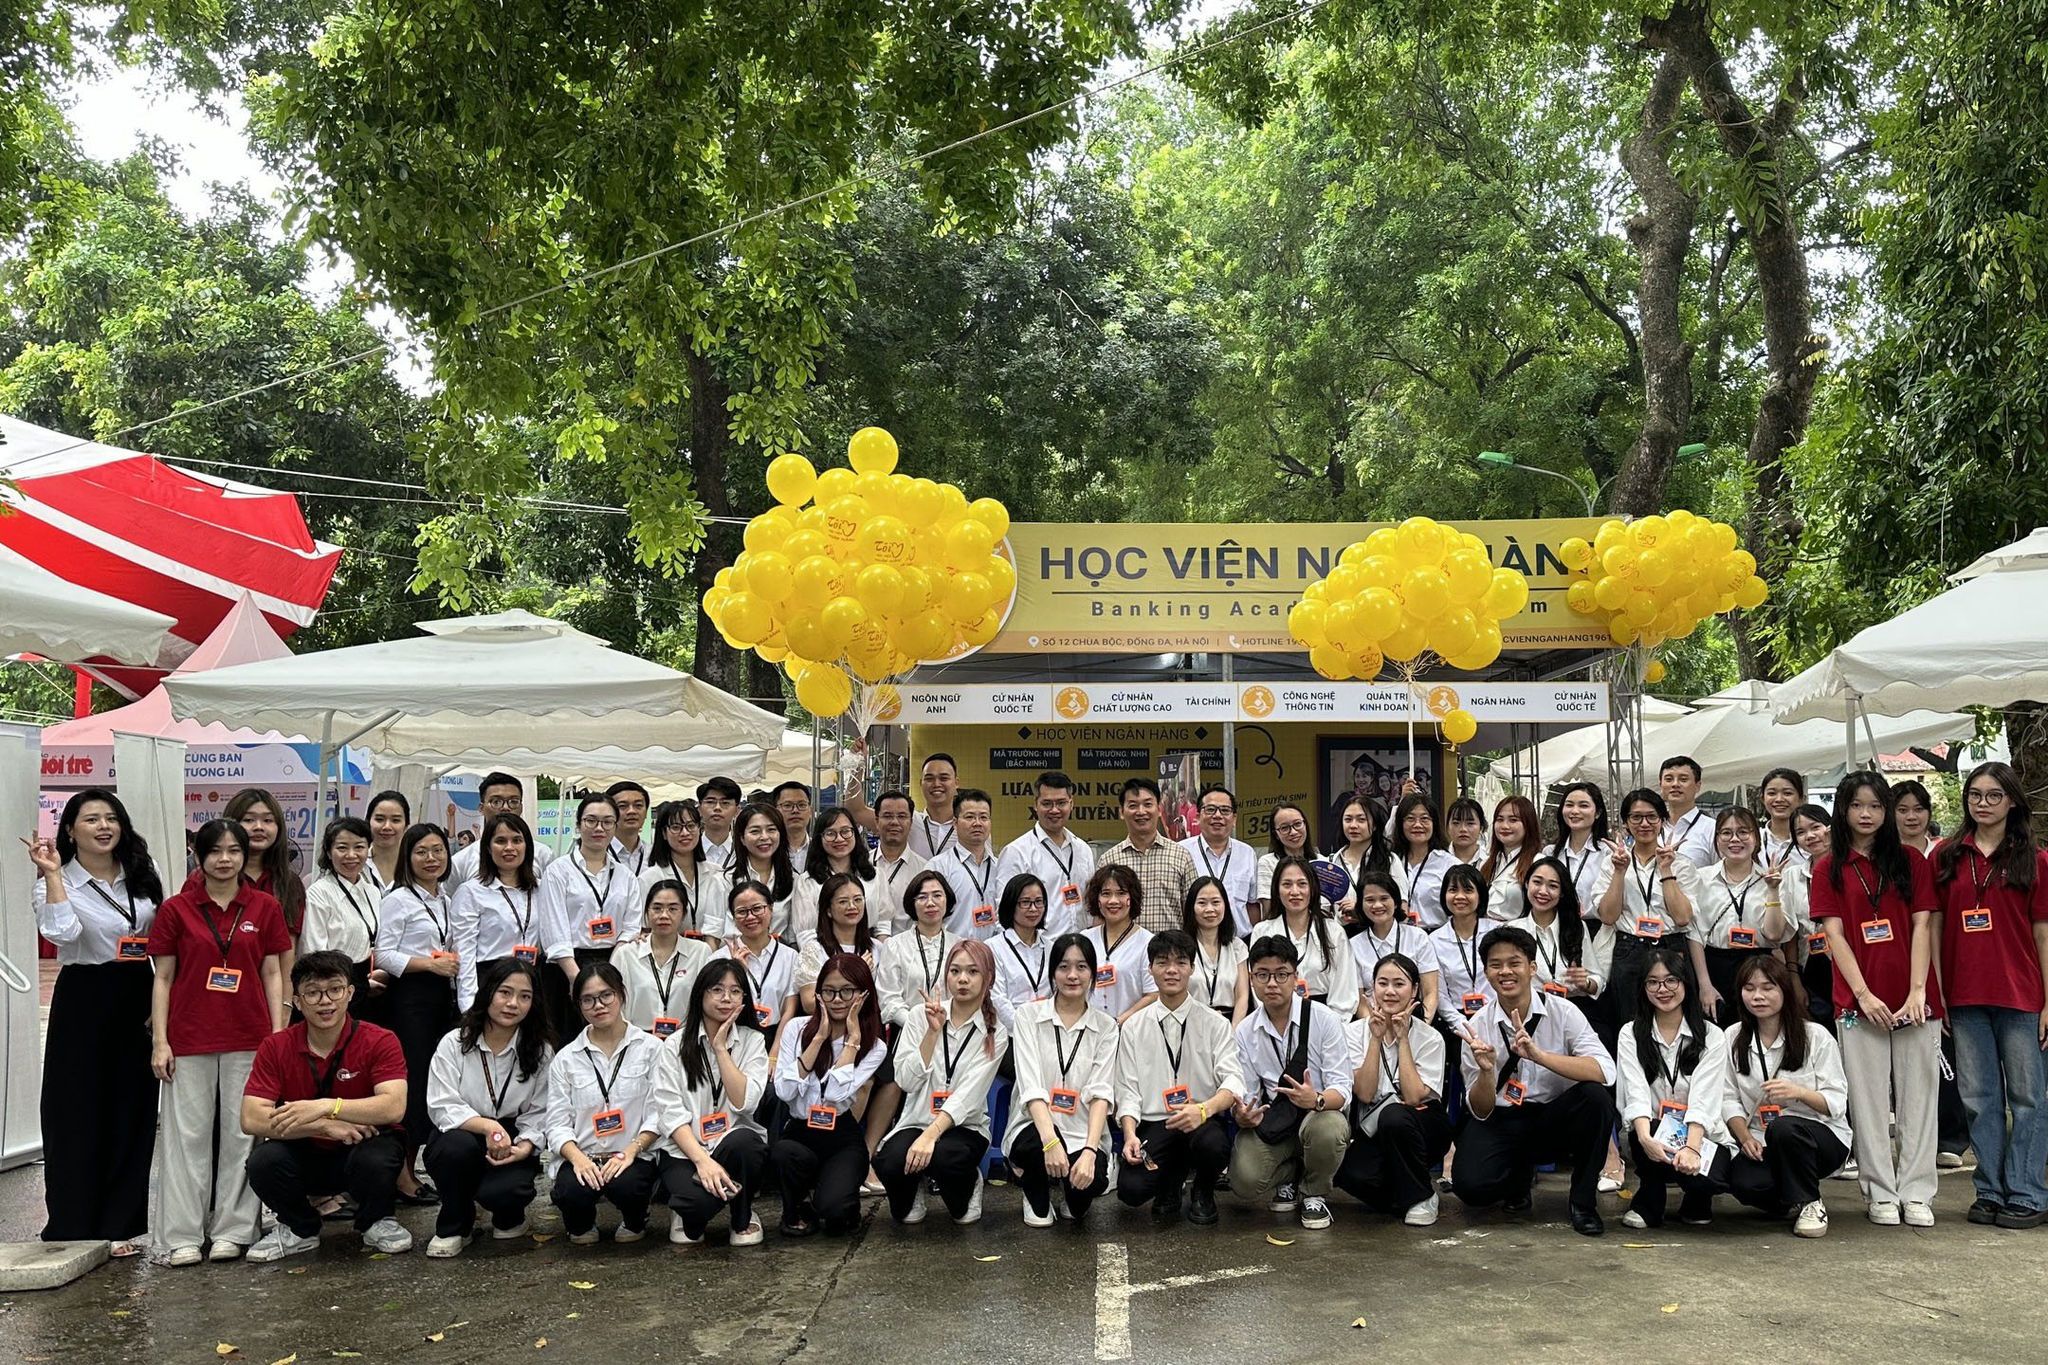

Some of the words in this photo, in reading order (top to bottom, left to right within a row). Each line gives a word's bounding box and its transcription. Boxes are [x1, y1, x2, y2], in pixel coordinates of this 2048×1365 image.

[1041, 547, 1147, 587] HỌC
[1163, 539, 1279, 587] VIỆN
[1091, 601, 1210, 619] Banking
[1042, 637, 1056, 646] SỐ
[1059, 638, 1070, 646] 12
[1175, 637, 1189, 646] HÀ
[1242, 638, 1283, 646] HOTLINE
[1502, 634, 1611, 643] CVIENNGANHANG1961
[911, 693, 938, 703] NGÔN
[940, 693, 961, 703] NGỮ
[992, 692, 1006, 702] CỬ
[1007, 692, 1034, 702] NHÂN
[1111, 692, 1126, 701] CỬ
[1127, 692, 1153, 701] NHÂN
[1283, 691, 1308, 700] CÔNG
[1310, 691, 1336, 701] NGHỆ
[1366, 691, 1392, 701] QUẢN
[1470, 695, 1497, 705] NGÂN
[1499, 695, 1526, 706] HÀNG
[1554, 691, 1568, 700] CỬ
[1570, 691, 1597, 700] NHÂN
[1185, 696, 1200, 706] TÀI
[1201, 696, 1231, 706] CHÍNH
[994, 703, 1020, 713] QUỐC
[1021, 703, 1033, 713] TẾ
[1092, 703, 1117, 712] CHẤT
[1119, 703, 1151, 713] LƯỢNG
[1153, 704, 1172, 712] CAO
[1285, 702, 1317, 711] THÔNG
[1320, 703, 1334, 711] TIN
[1359, 703, 1380, 711] KINH
[1556, 703, 1582, 711] QUỐC
[1584, 702, 1596, 711] TẾ
[1036, 728, 1066, 741] HỌC
[1070, 726, 1101, 741] VIỆN
[1105, 726, 1145, 740] NGÂN
[1149, 726, 1189, 740] HÀNG
[1025, 760, 1048, 768] NINH)
[228, 767, 244, 776] LAI
[1001, 782, 1034, 799] LỰA
[1289, 792, 1307, 801] SINH
